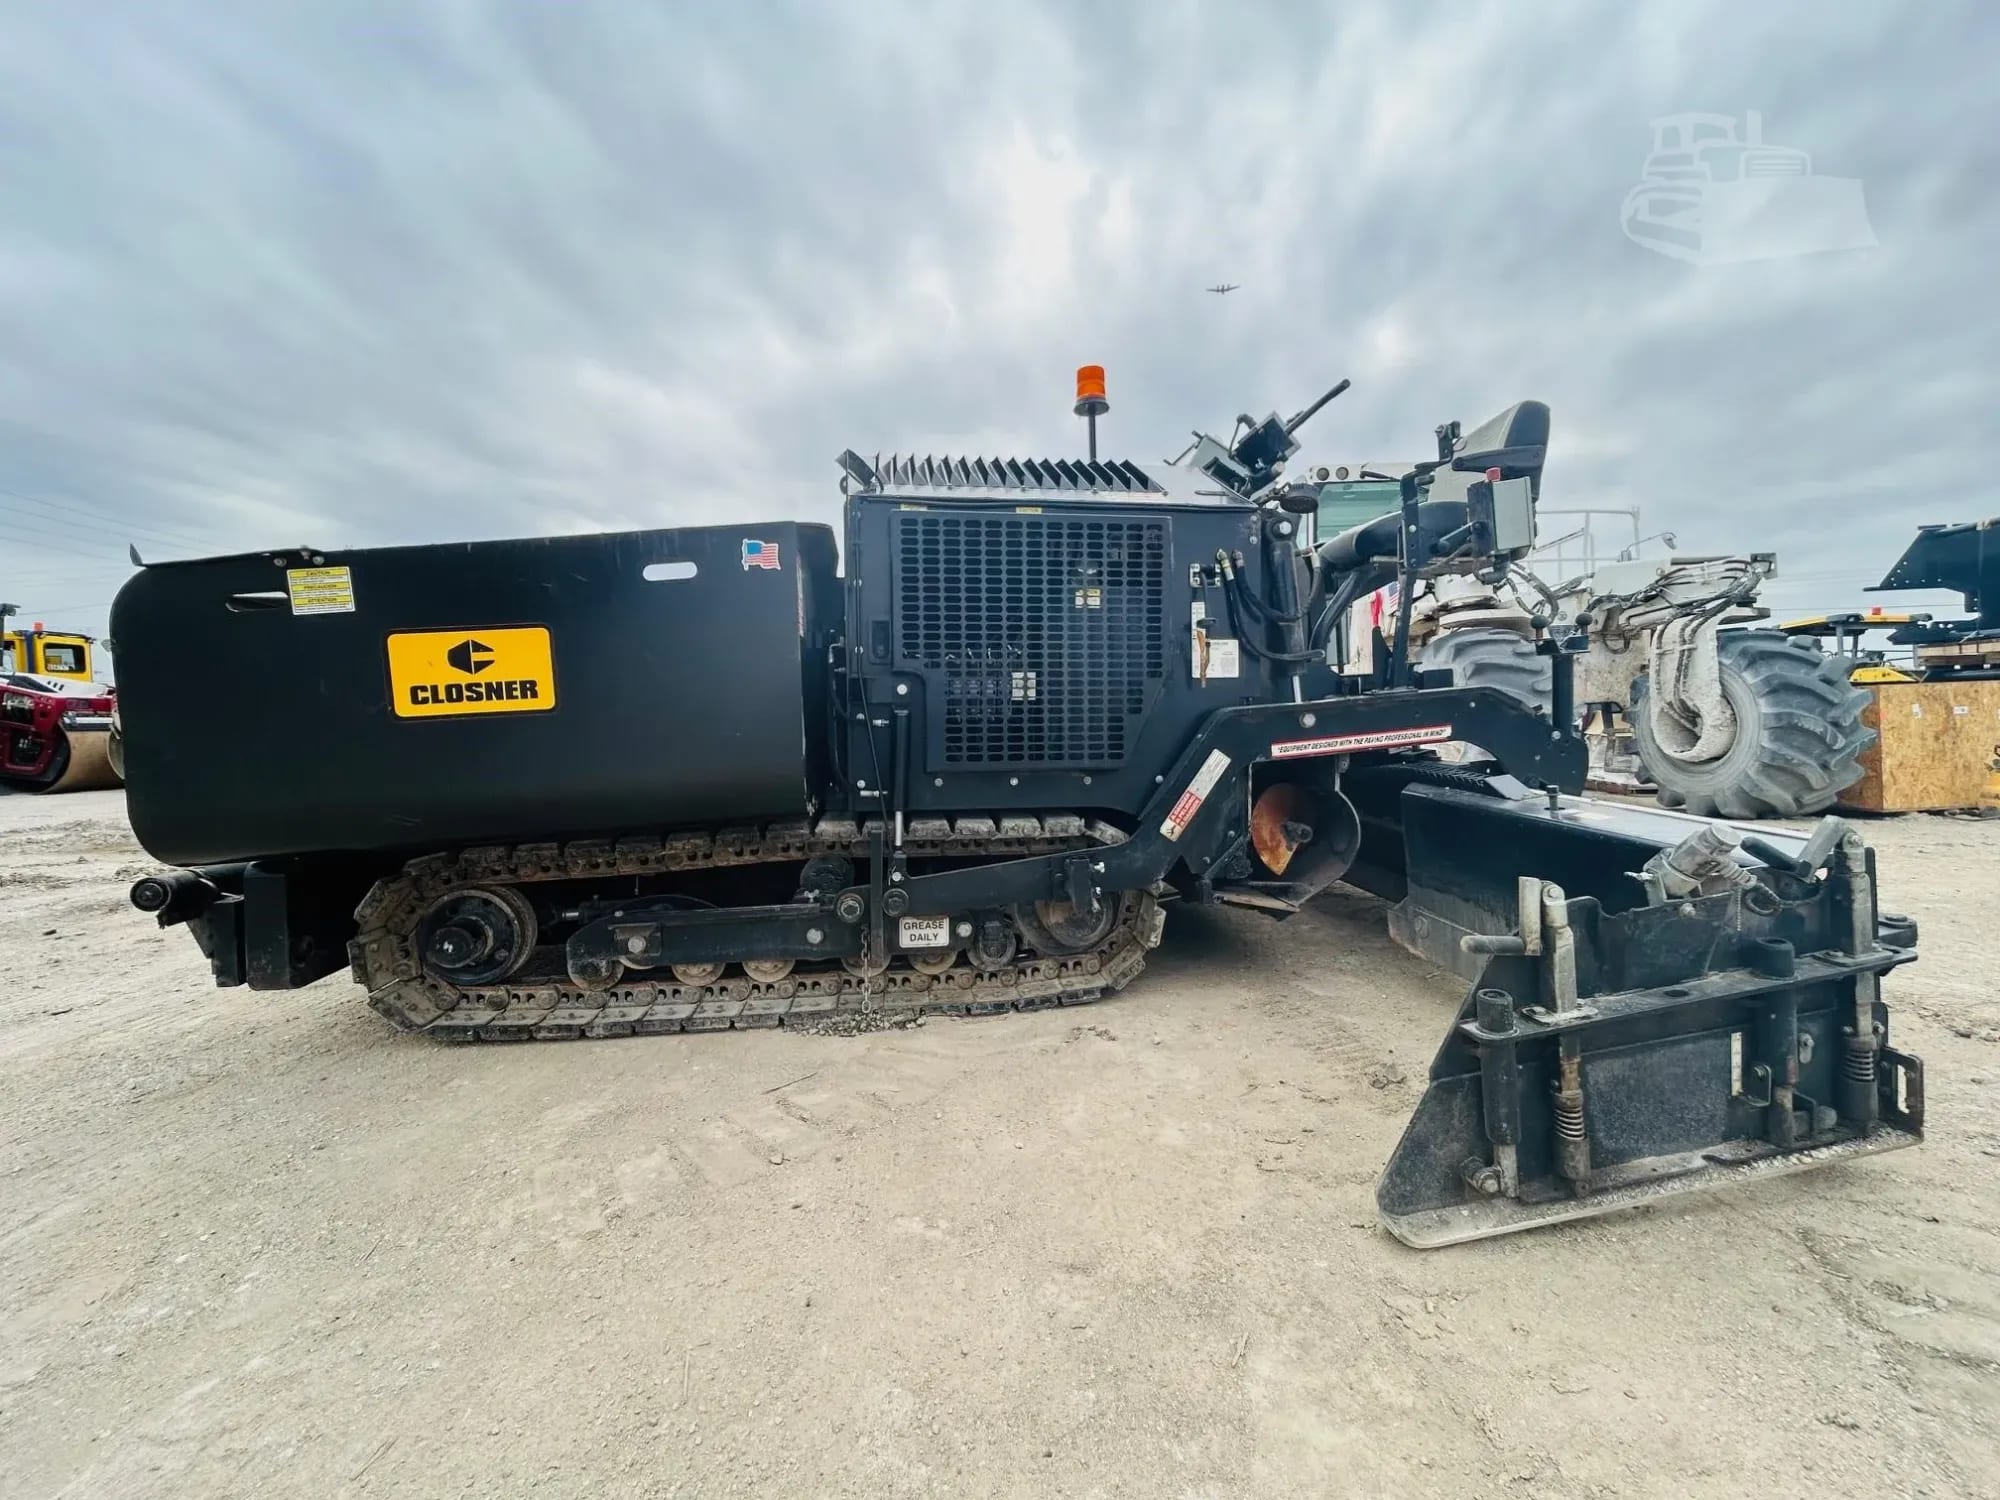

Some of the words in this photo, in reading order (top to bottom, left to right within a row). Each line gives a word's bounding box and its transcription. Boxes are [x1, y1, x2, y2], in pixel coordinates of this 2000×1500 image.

[410, 680, 538, 705] CLOSNER
[1310, 740, 1337, 749] DESIGNED
[1338, 738, 1352, 746] WITH
[1363, 735, 1384, 744] PAVING
[1384, 731, 1421, 741] PROFESSIONAL
[903, 920, 945, 930] GREASE
[910, 933, 939, 942] DAILY
